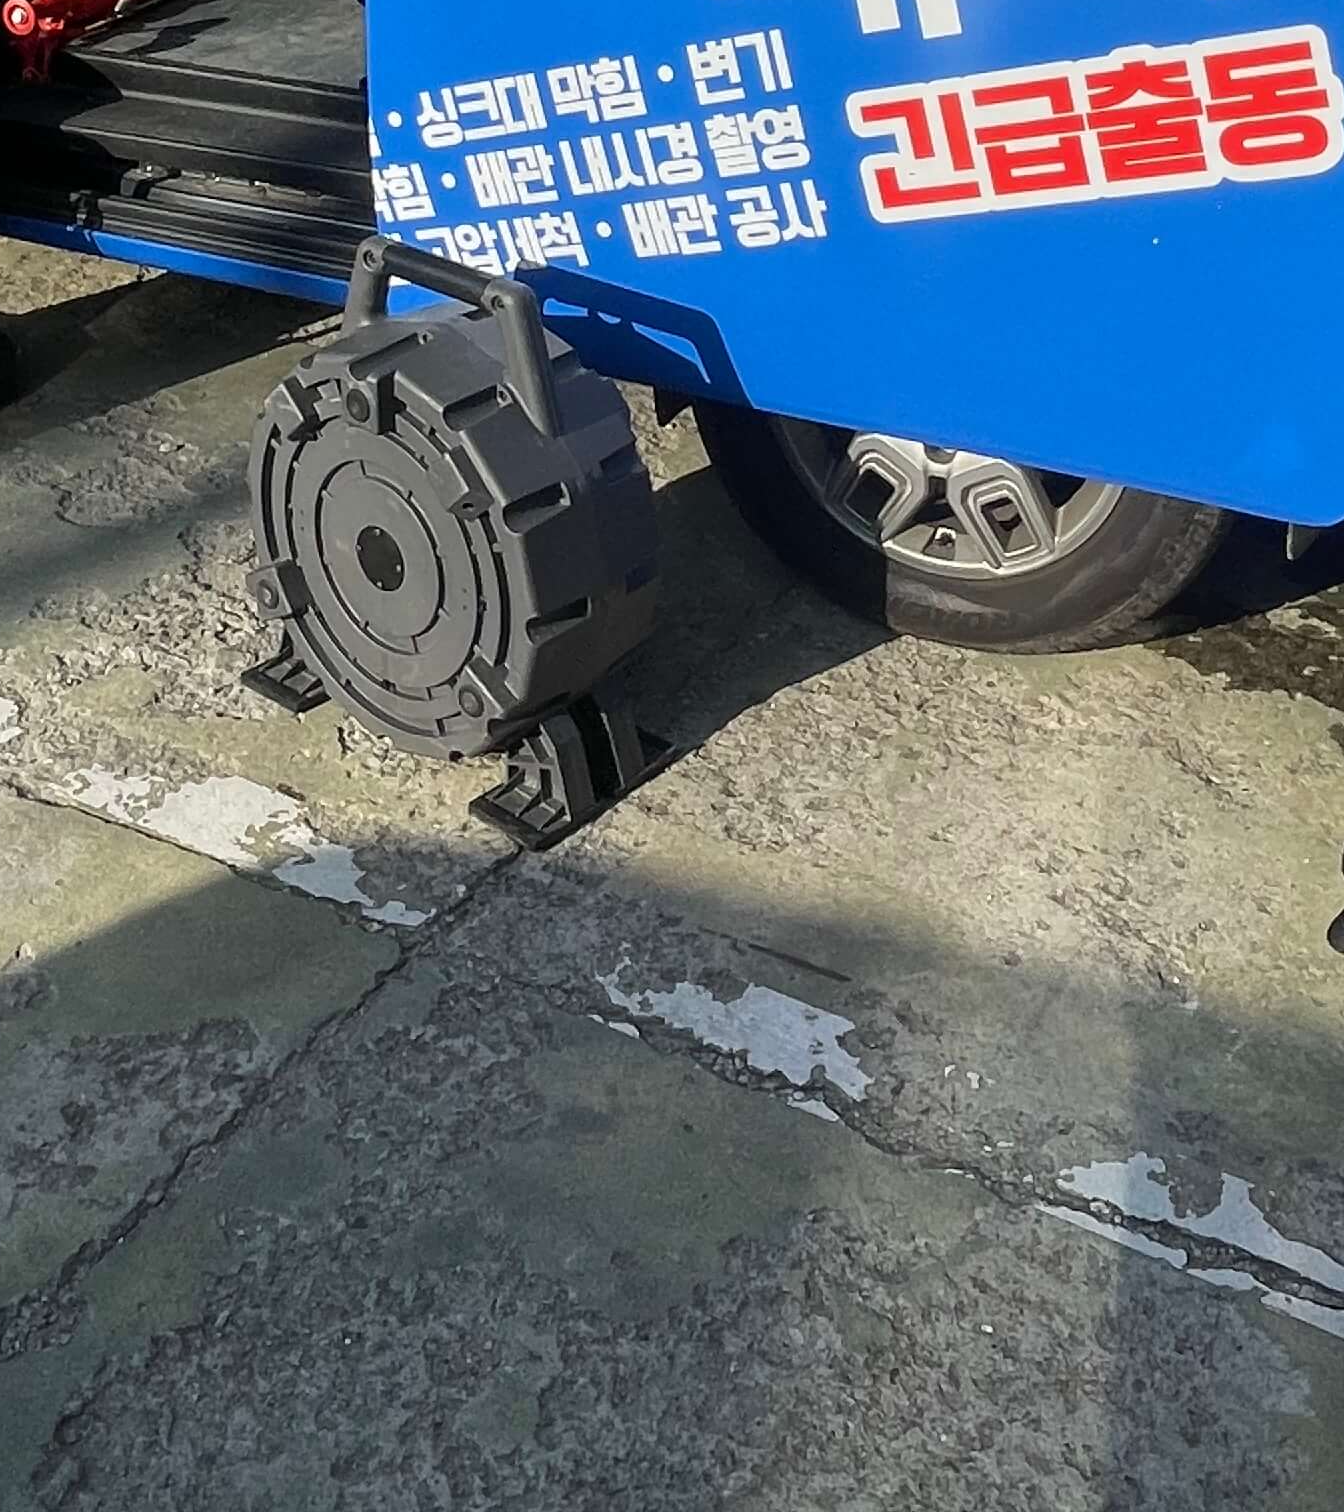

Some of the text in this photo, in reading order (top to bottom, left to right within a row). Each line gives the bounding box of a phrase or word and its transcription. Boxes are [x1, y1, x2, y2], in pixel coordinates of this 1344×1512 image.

[416, 72, 548, 149] 싱크대
[546, 55, 648, 125] 막힘
[686, 28, 794, 106] 변기
[861, 40, 1331, 210] 긴급출동
[464, 143, 560, 209] 배관
[559, 120, 705, 197] 내시경
[702, 104, 812, 179] 촬영
[621, 193, 724, 259] 배관
[725, 178, 829, 249] 공사
